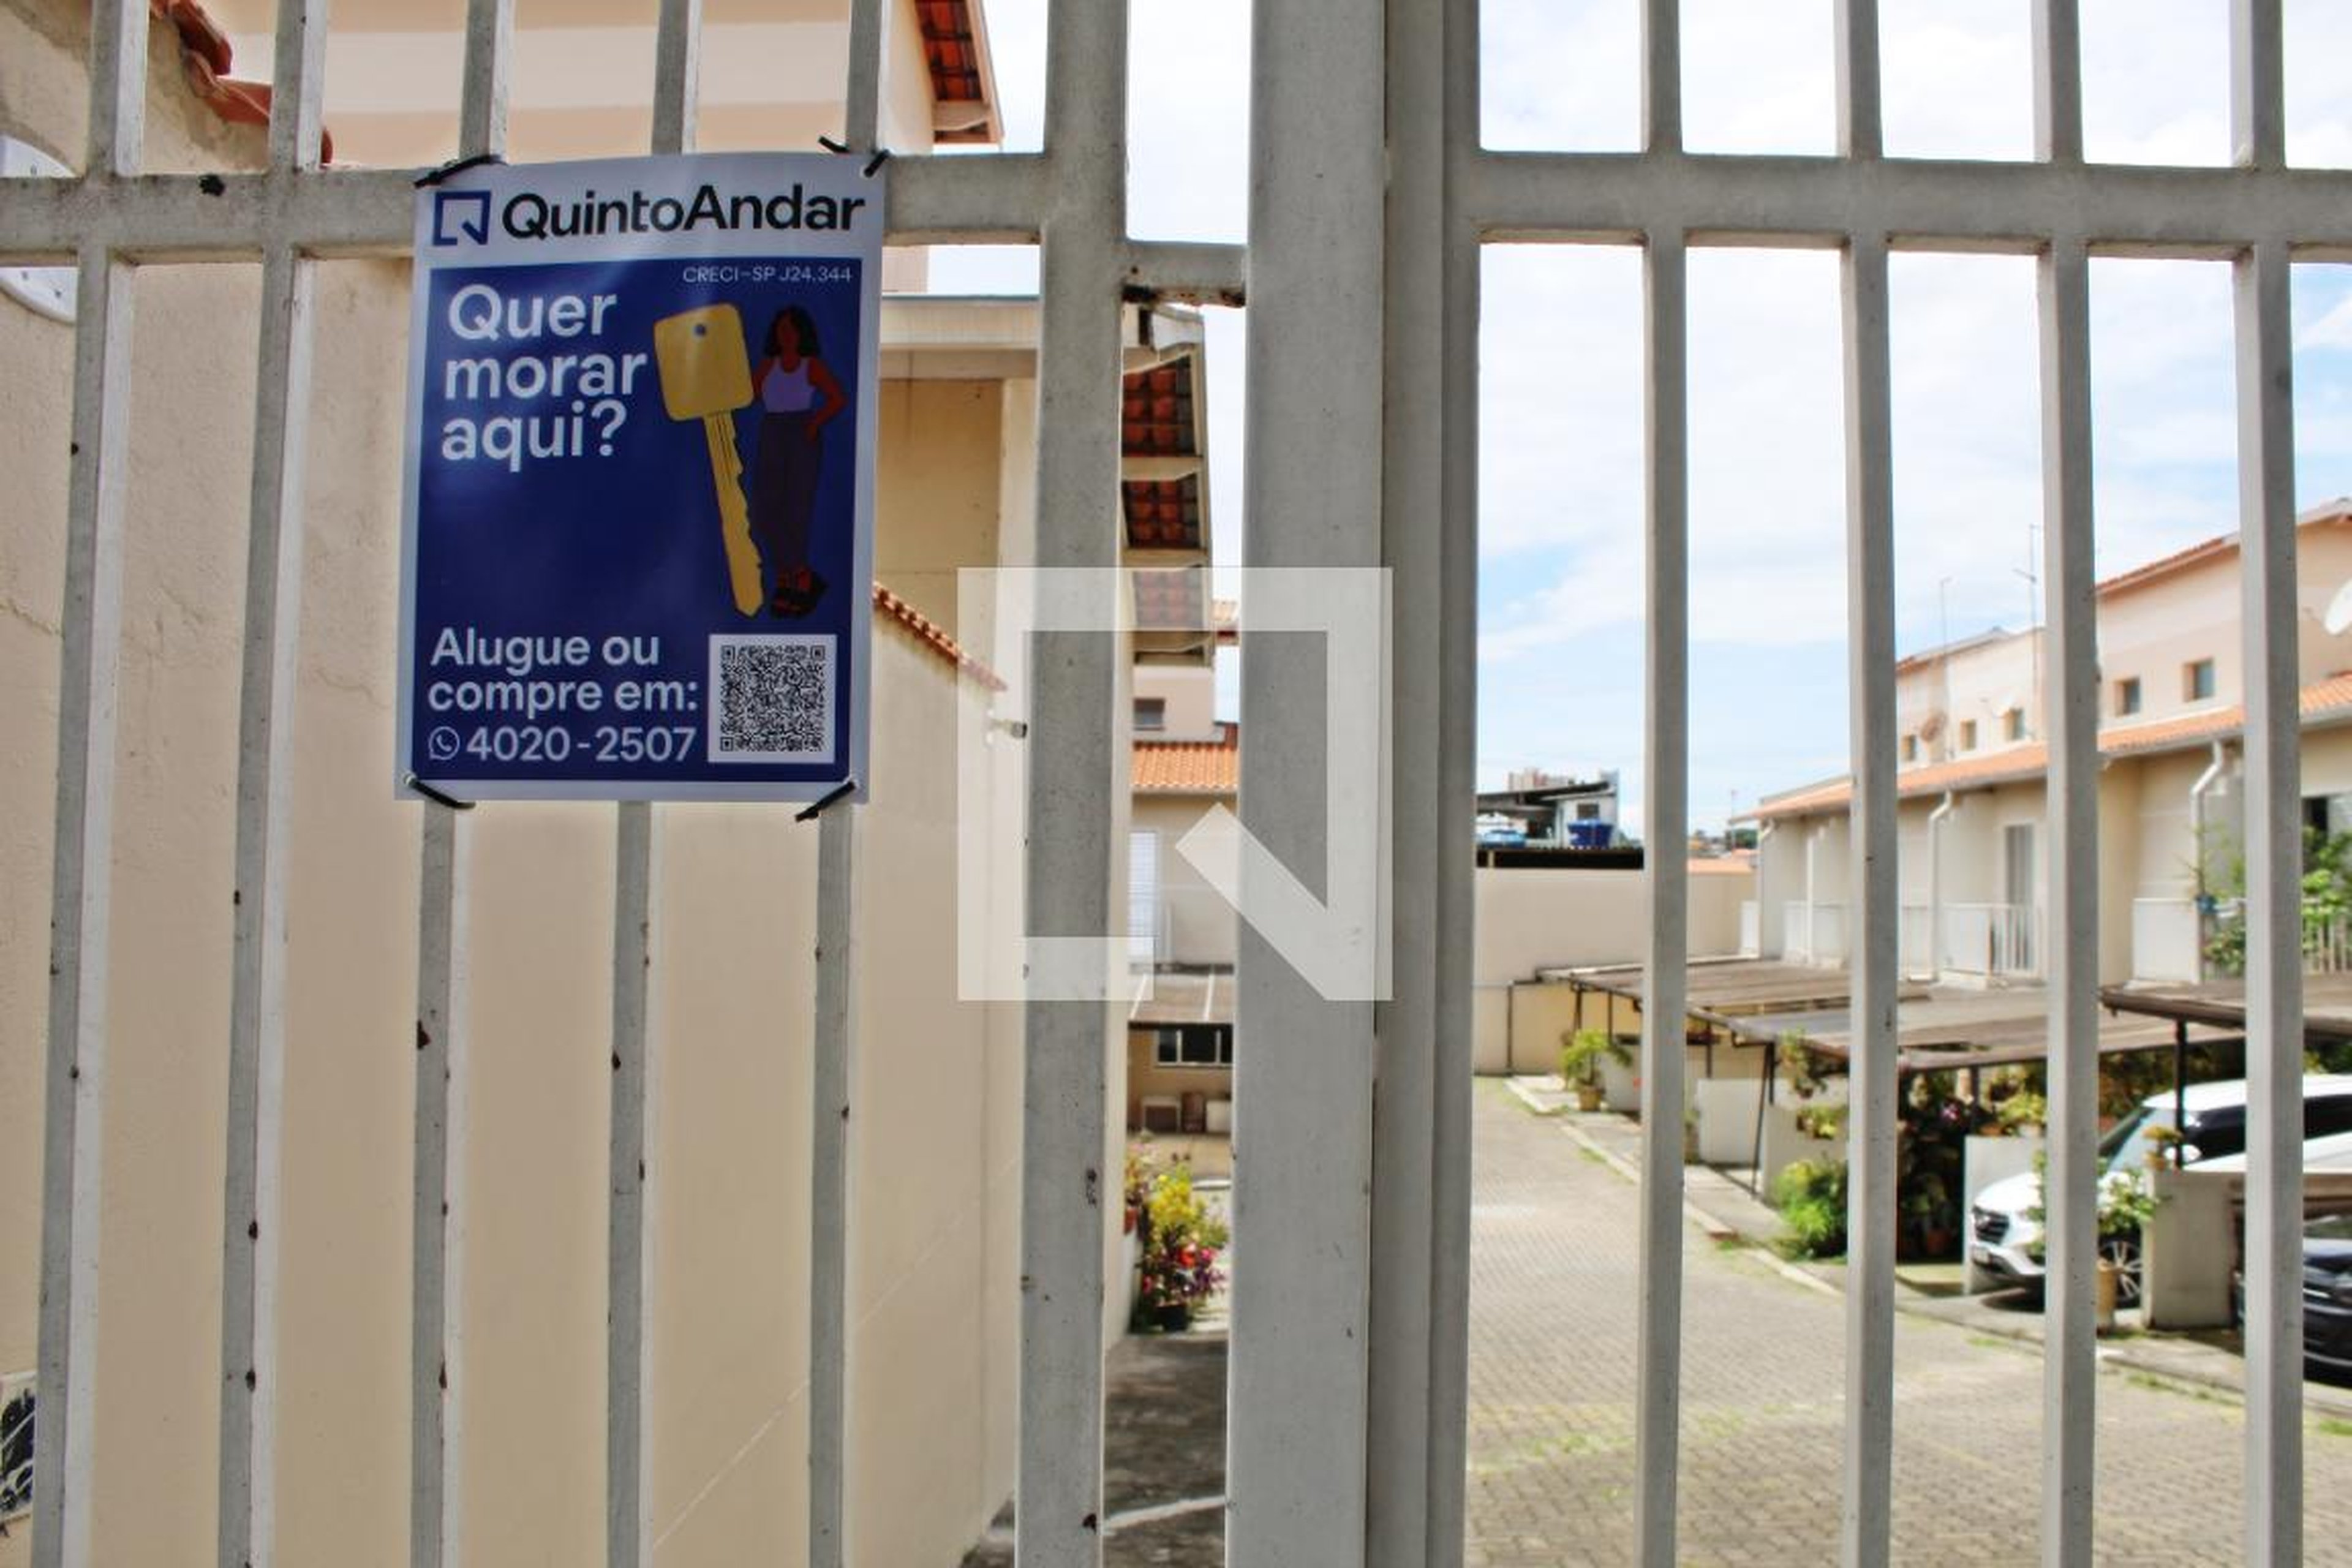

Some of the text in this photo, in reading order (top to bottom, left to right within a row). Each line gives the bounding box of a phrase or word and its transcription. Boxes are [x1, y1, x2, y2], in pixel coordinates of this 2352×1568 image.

[502, 183, 865, 239] QuintoAndar
[683, 266, 852, 283] CRECI-SP J24.344
[448, 284, 617, 340] Quer
[445, 351, 649, 399] morar
[441, 399, 627, 473] aqui?
[430, 627, 660, 676] Alugue ou
[428, 679, 699, 720] compre em:
[466, 726, 696, 762] 4020-2507
